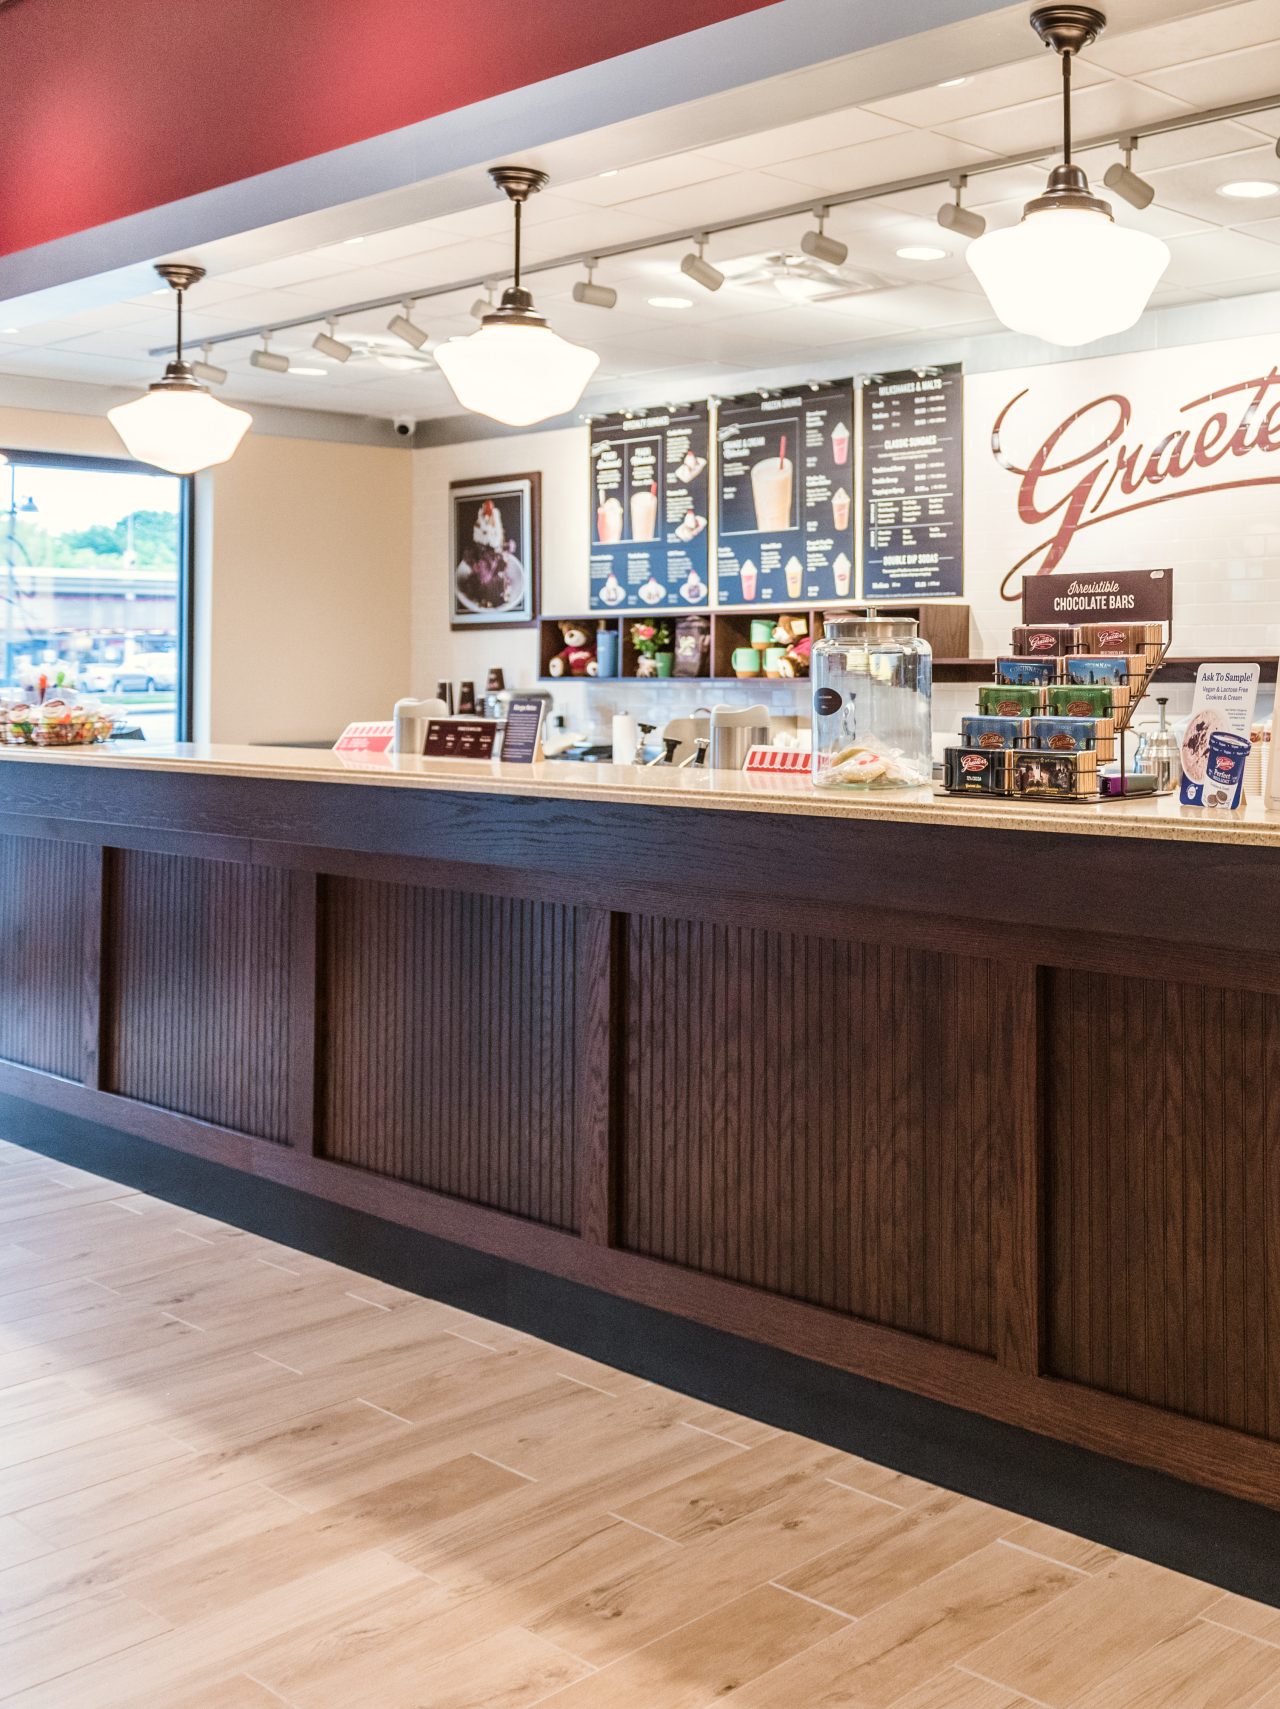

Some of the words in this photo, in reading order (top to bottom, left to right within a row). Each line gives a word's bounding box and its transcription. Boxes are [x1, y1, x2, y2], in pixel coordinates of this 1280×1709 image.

[1068, 581, 1119, 595] Irresistible
[1054, 596, 1106, 611] CHOCOLATE
[1109, 595, 1134, 609] BARS
[1202, 673, 1214, 681] Ask
[1216, 673, 1224, 681] To
[1225, 673, 1253, 683] Sample!
